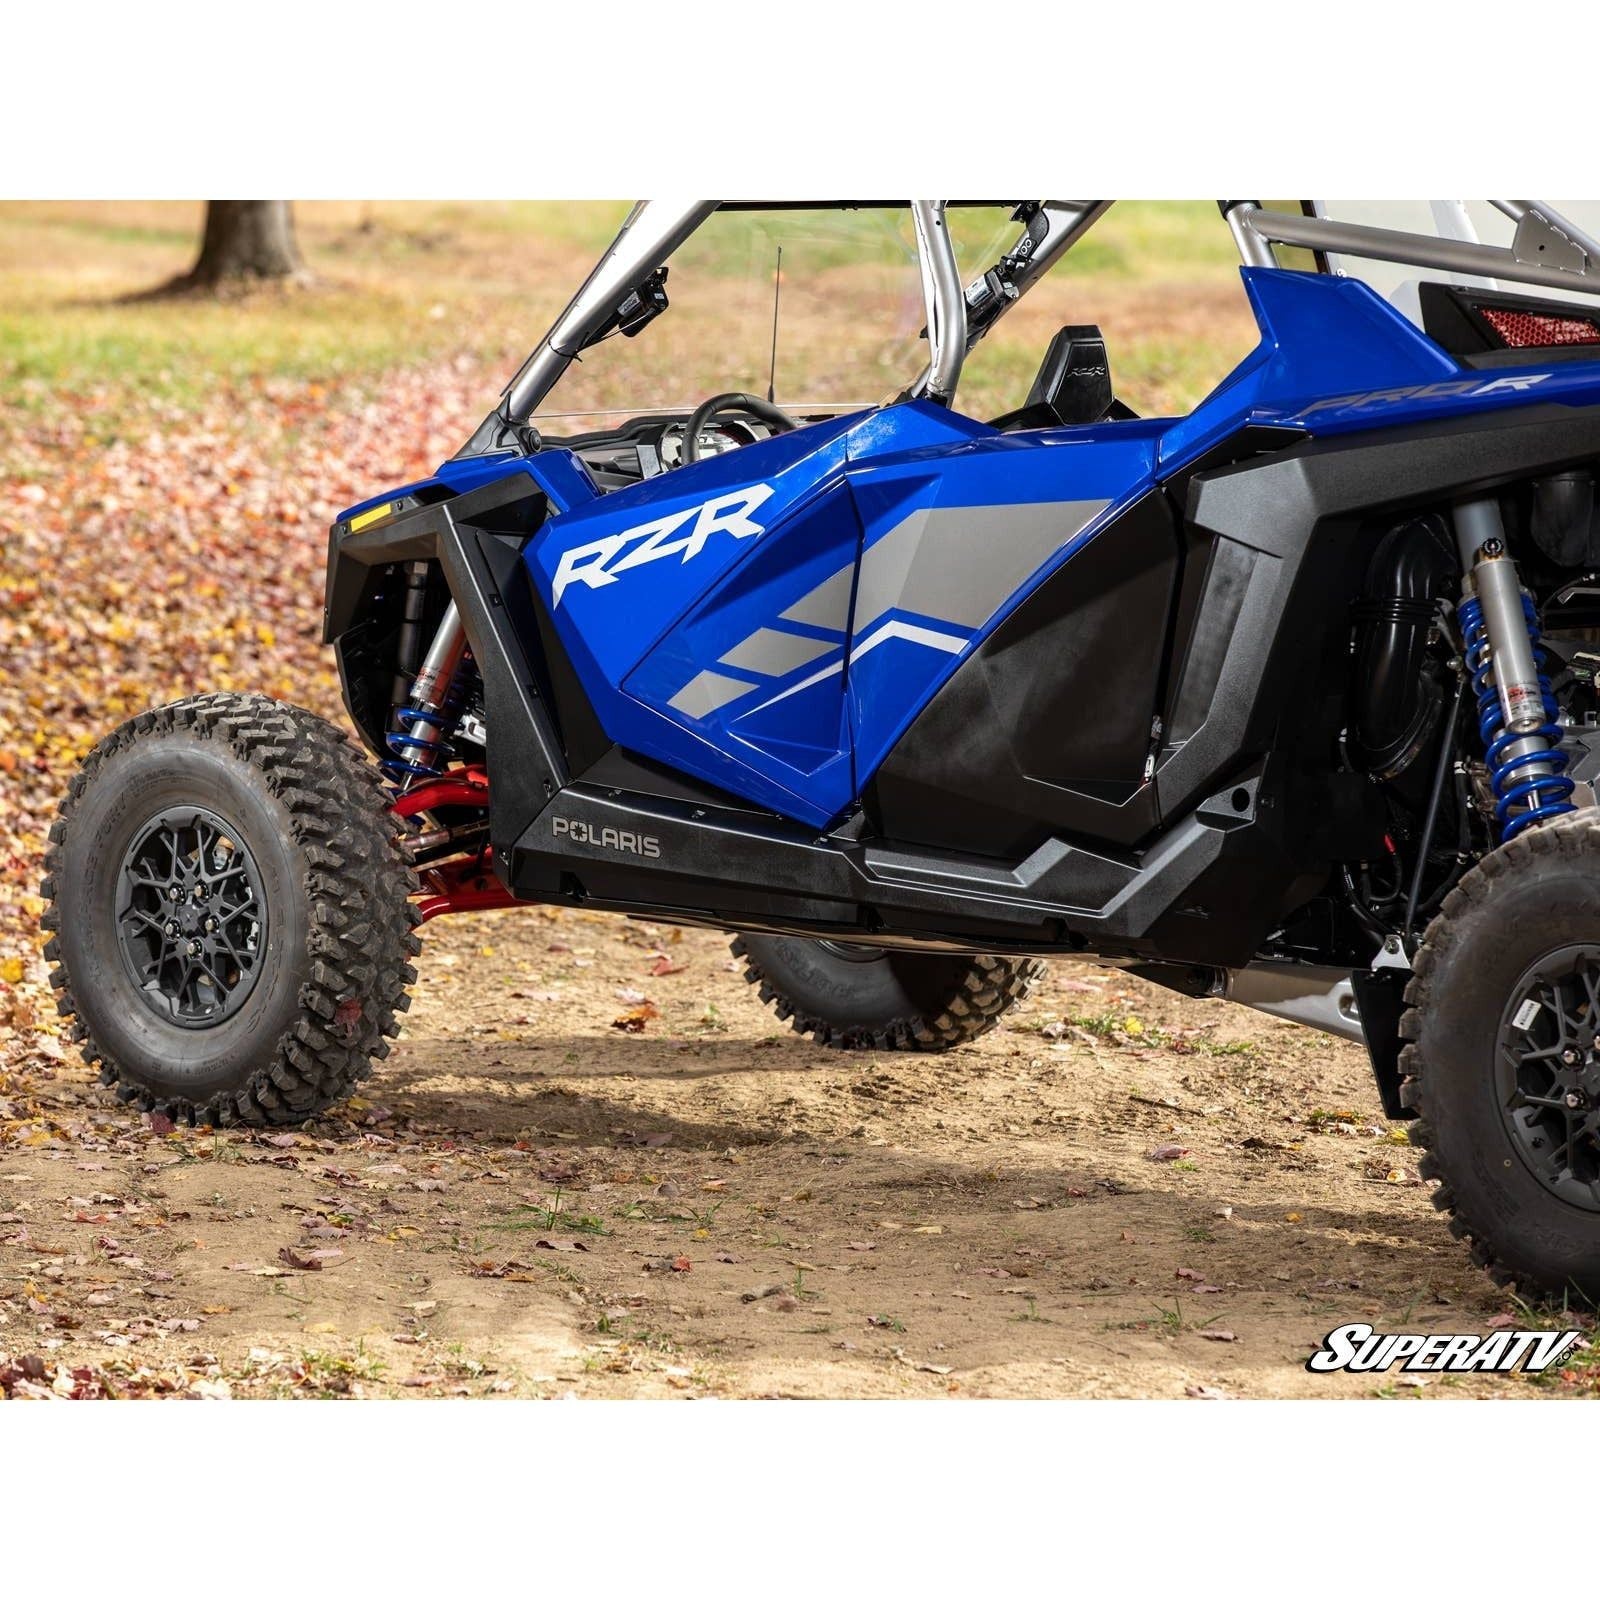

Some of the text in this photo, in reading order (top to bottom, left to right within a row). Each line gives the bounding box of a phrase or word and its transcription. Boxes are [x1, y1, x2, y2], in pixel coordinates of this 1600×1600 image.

[1471, 373, 1554, 396] R
[552, 482, 776, 612] RZR
[552, 816, 661, 858] POLARIS
